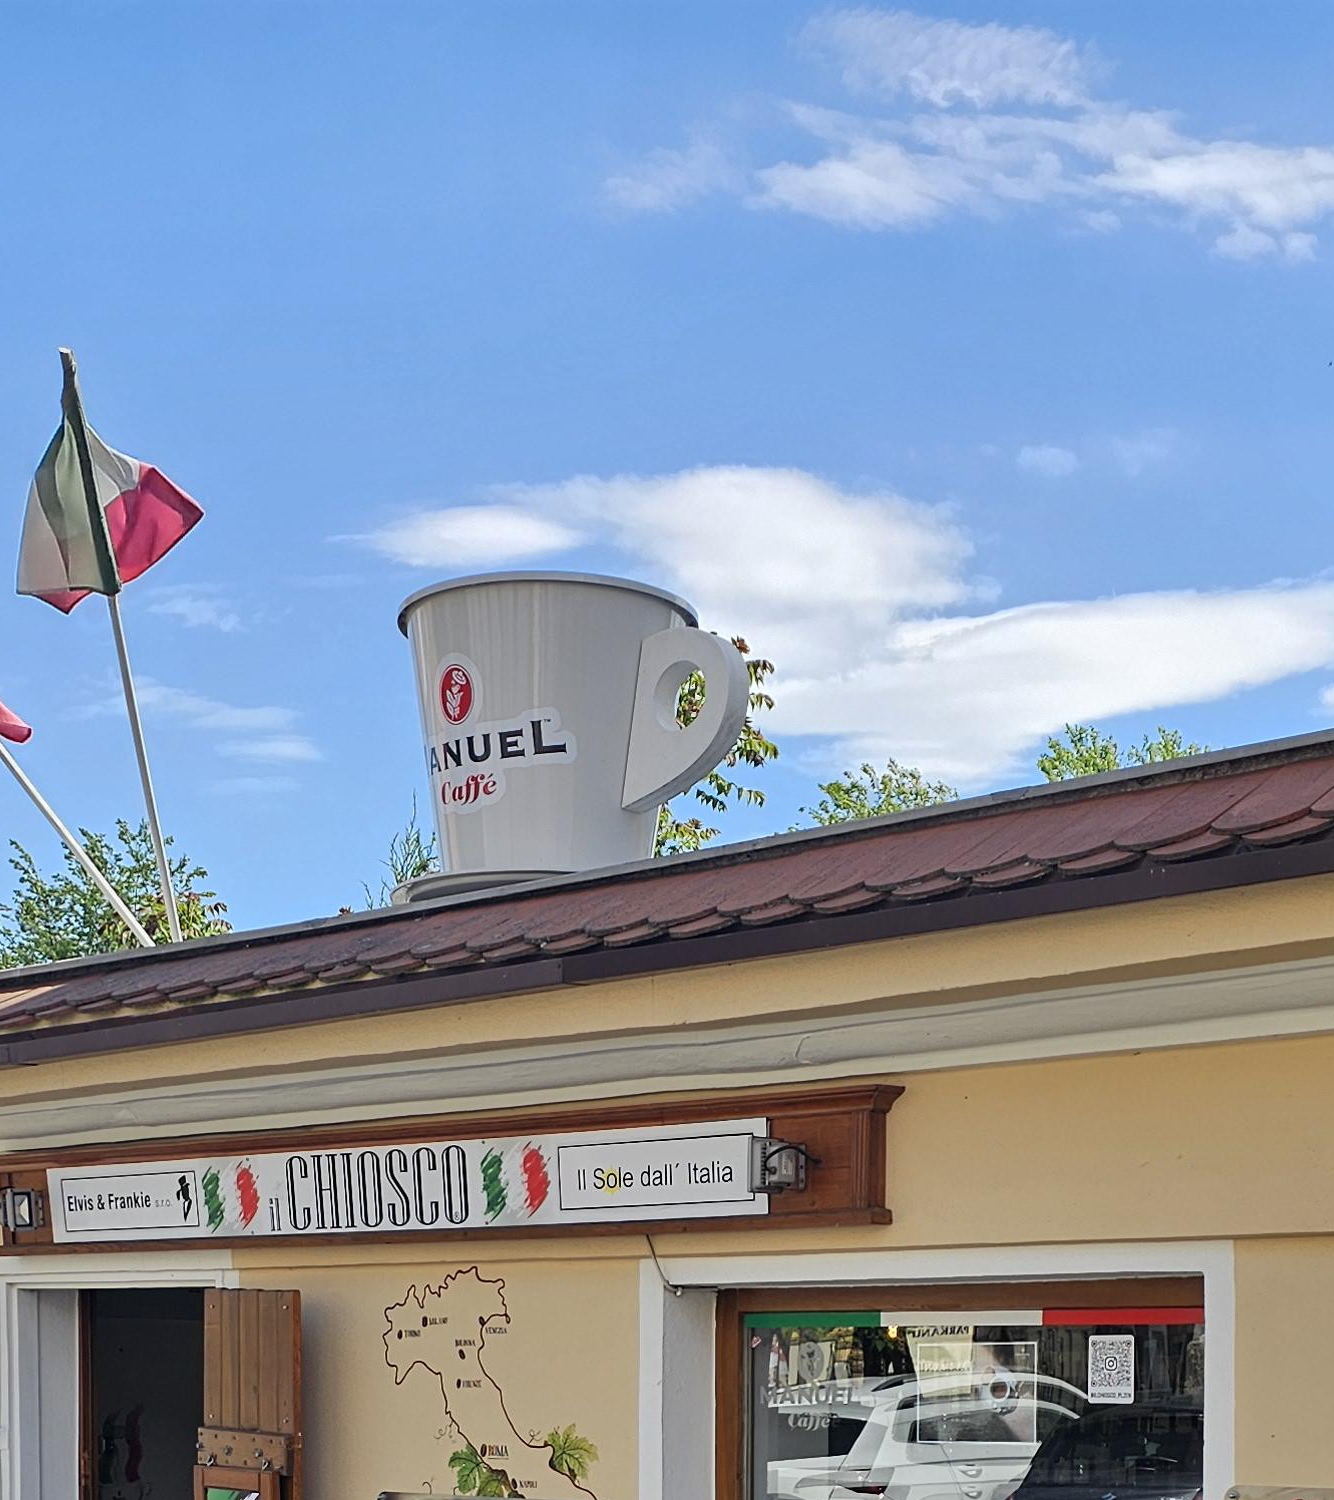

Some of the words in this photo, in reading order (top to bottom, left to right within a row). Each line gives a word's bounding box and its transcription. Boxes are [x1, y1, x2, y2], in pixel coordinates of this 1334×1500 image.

[441, 773, 497, 806] Caffé
[269, 1197, 282, 1231] il
[285, 1144, 470, 1231] CHIOSCO
[577, 1168, 587, 1191] Il
[593, 1166, 634, 1191] Sole
[687, 1160, 734, 1185] Italia
[67, 1194, 94, 1212] Elvis
[96, 1194, 106, 1211] &
[108, 1191, 152, 1210] Frankie
[154, 1198, 173, 1209] s.r.o.
